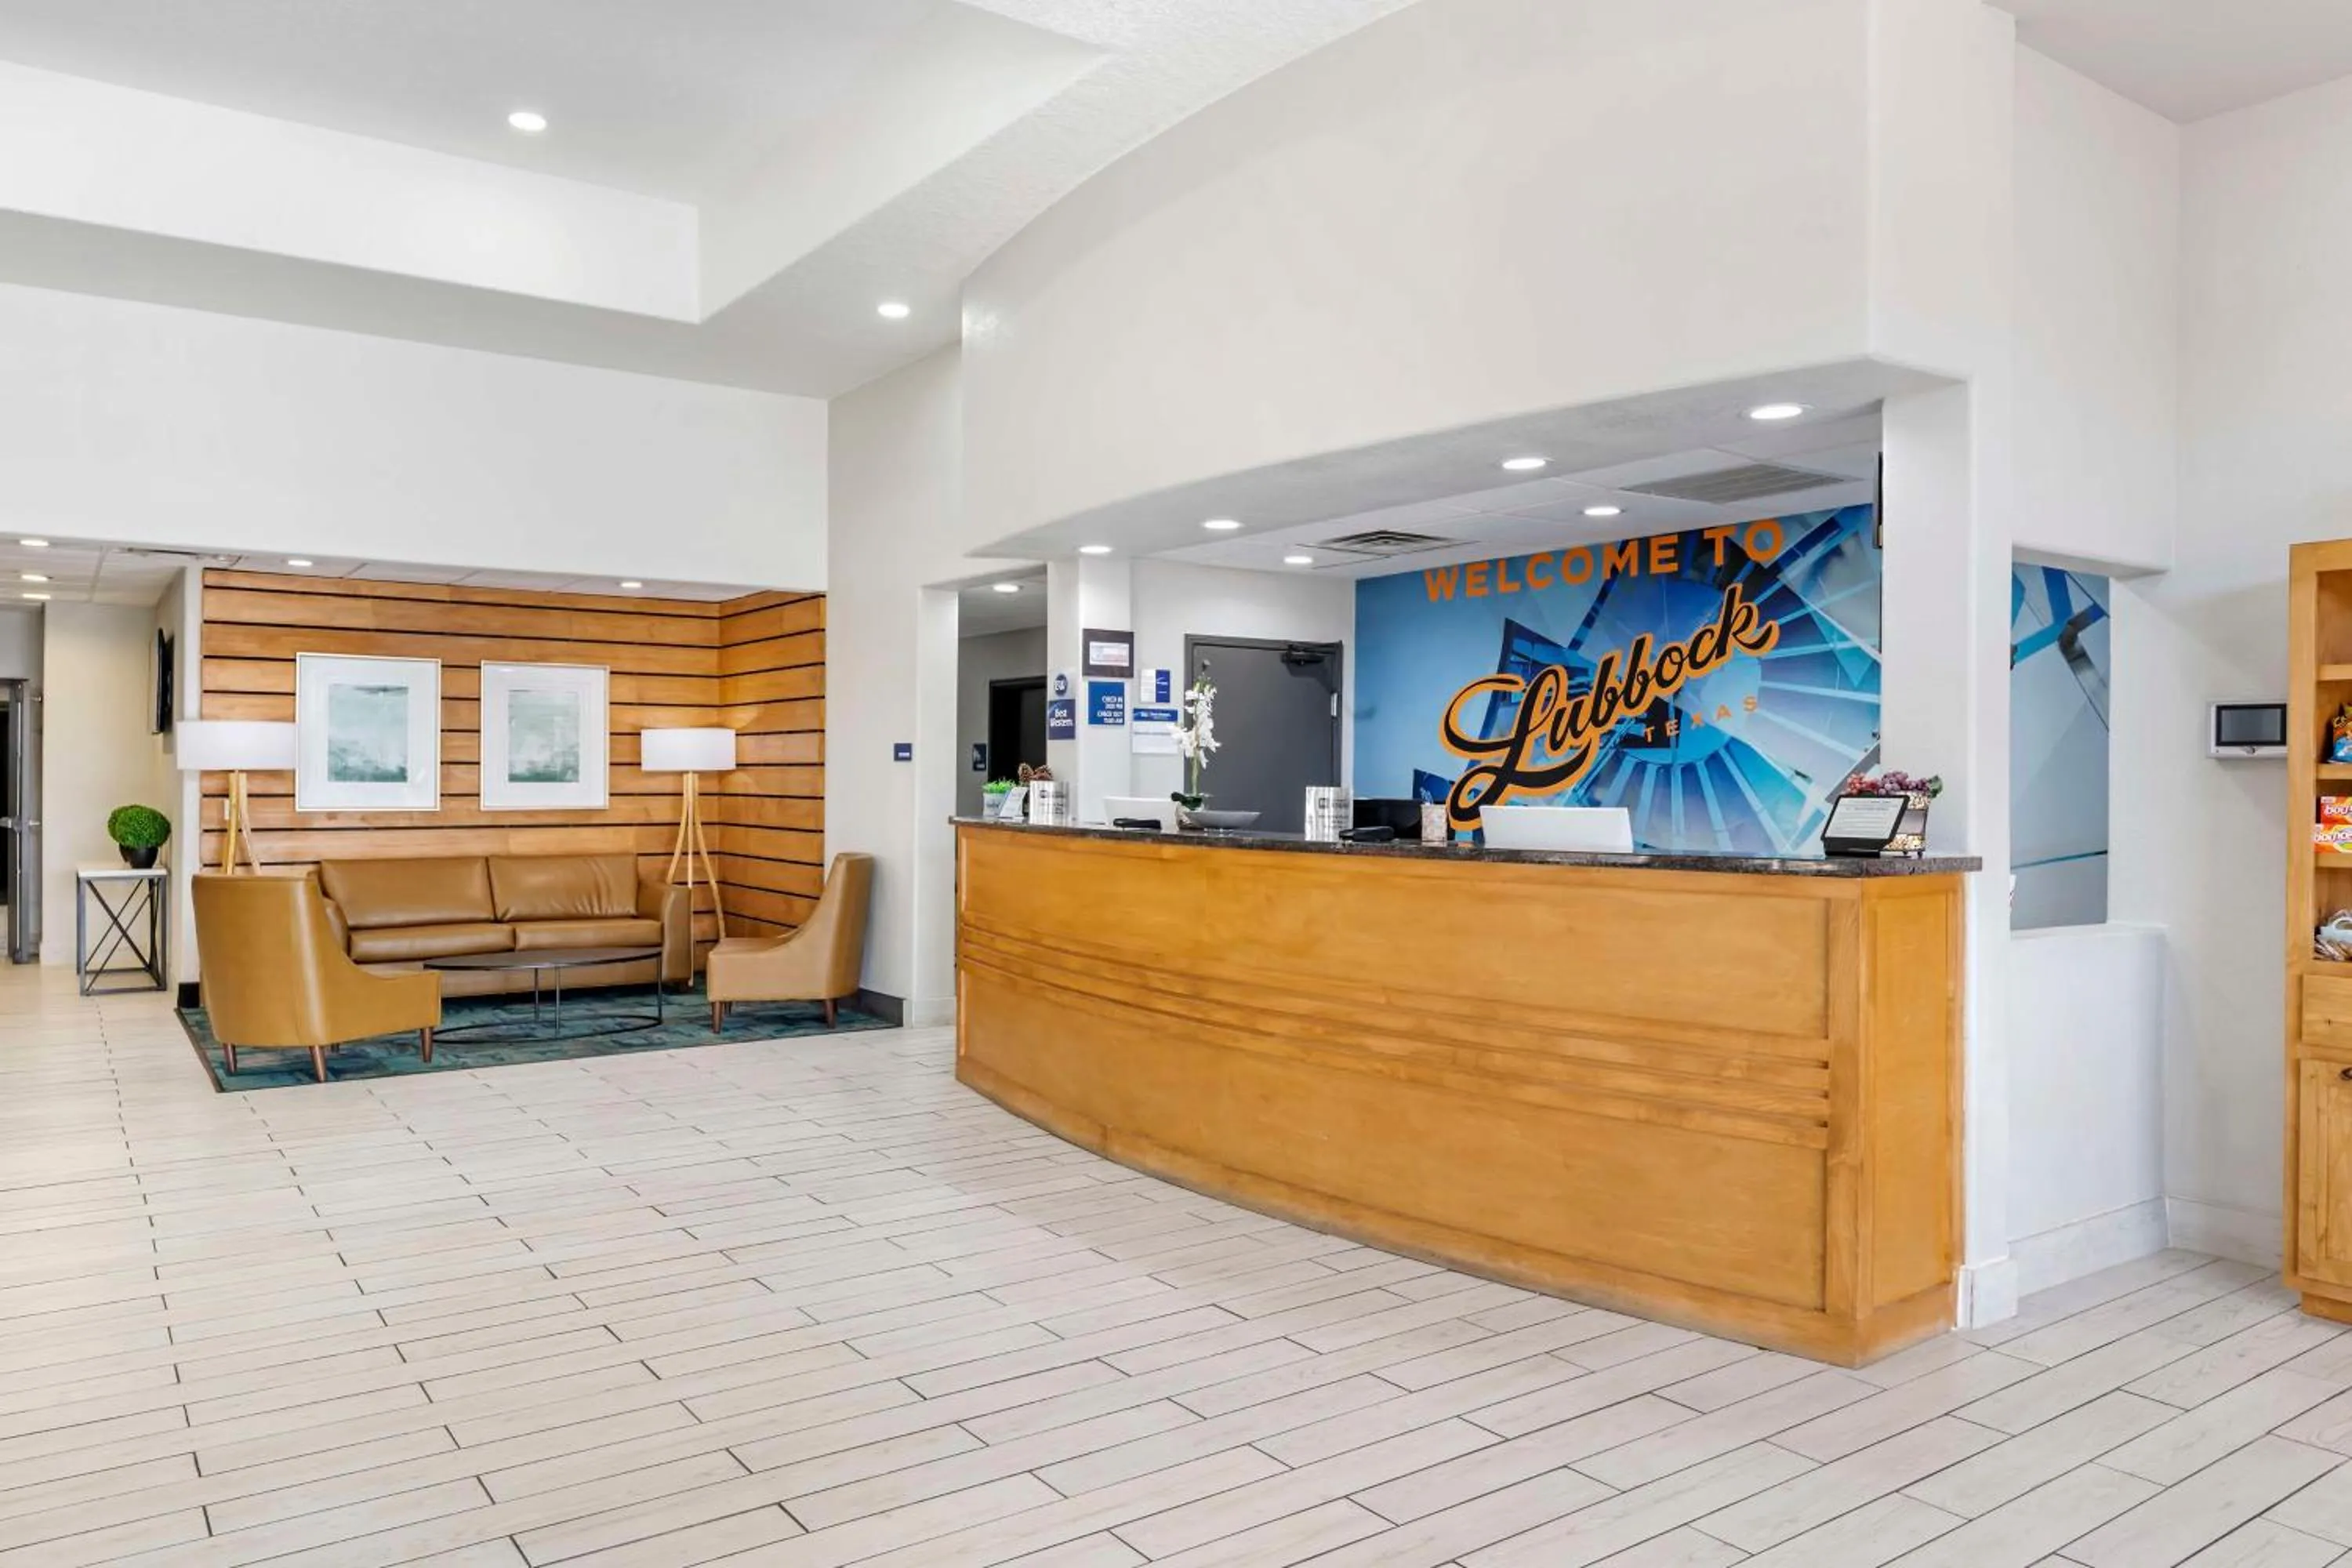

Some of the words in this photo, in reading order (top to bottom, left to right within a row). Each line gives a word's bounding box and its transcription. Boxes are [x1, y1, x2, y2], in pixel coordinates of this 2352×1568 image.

[1423, 533, 1679, 602] WELCOME
[1703, 518, 1784, 568] TO
[1050, 717, 1073, 728] Western
[1054, 708, 1067, 717] Best
[1439, 583, 1780, 831] Lubbock
[1643, 695, 1758, 742] TEXAS
